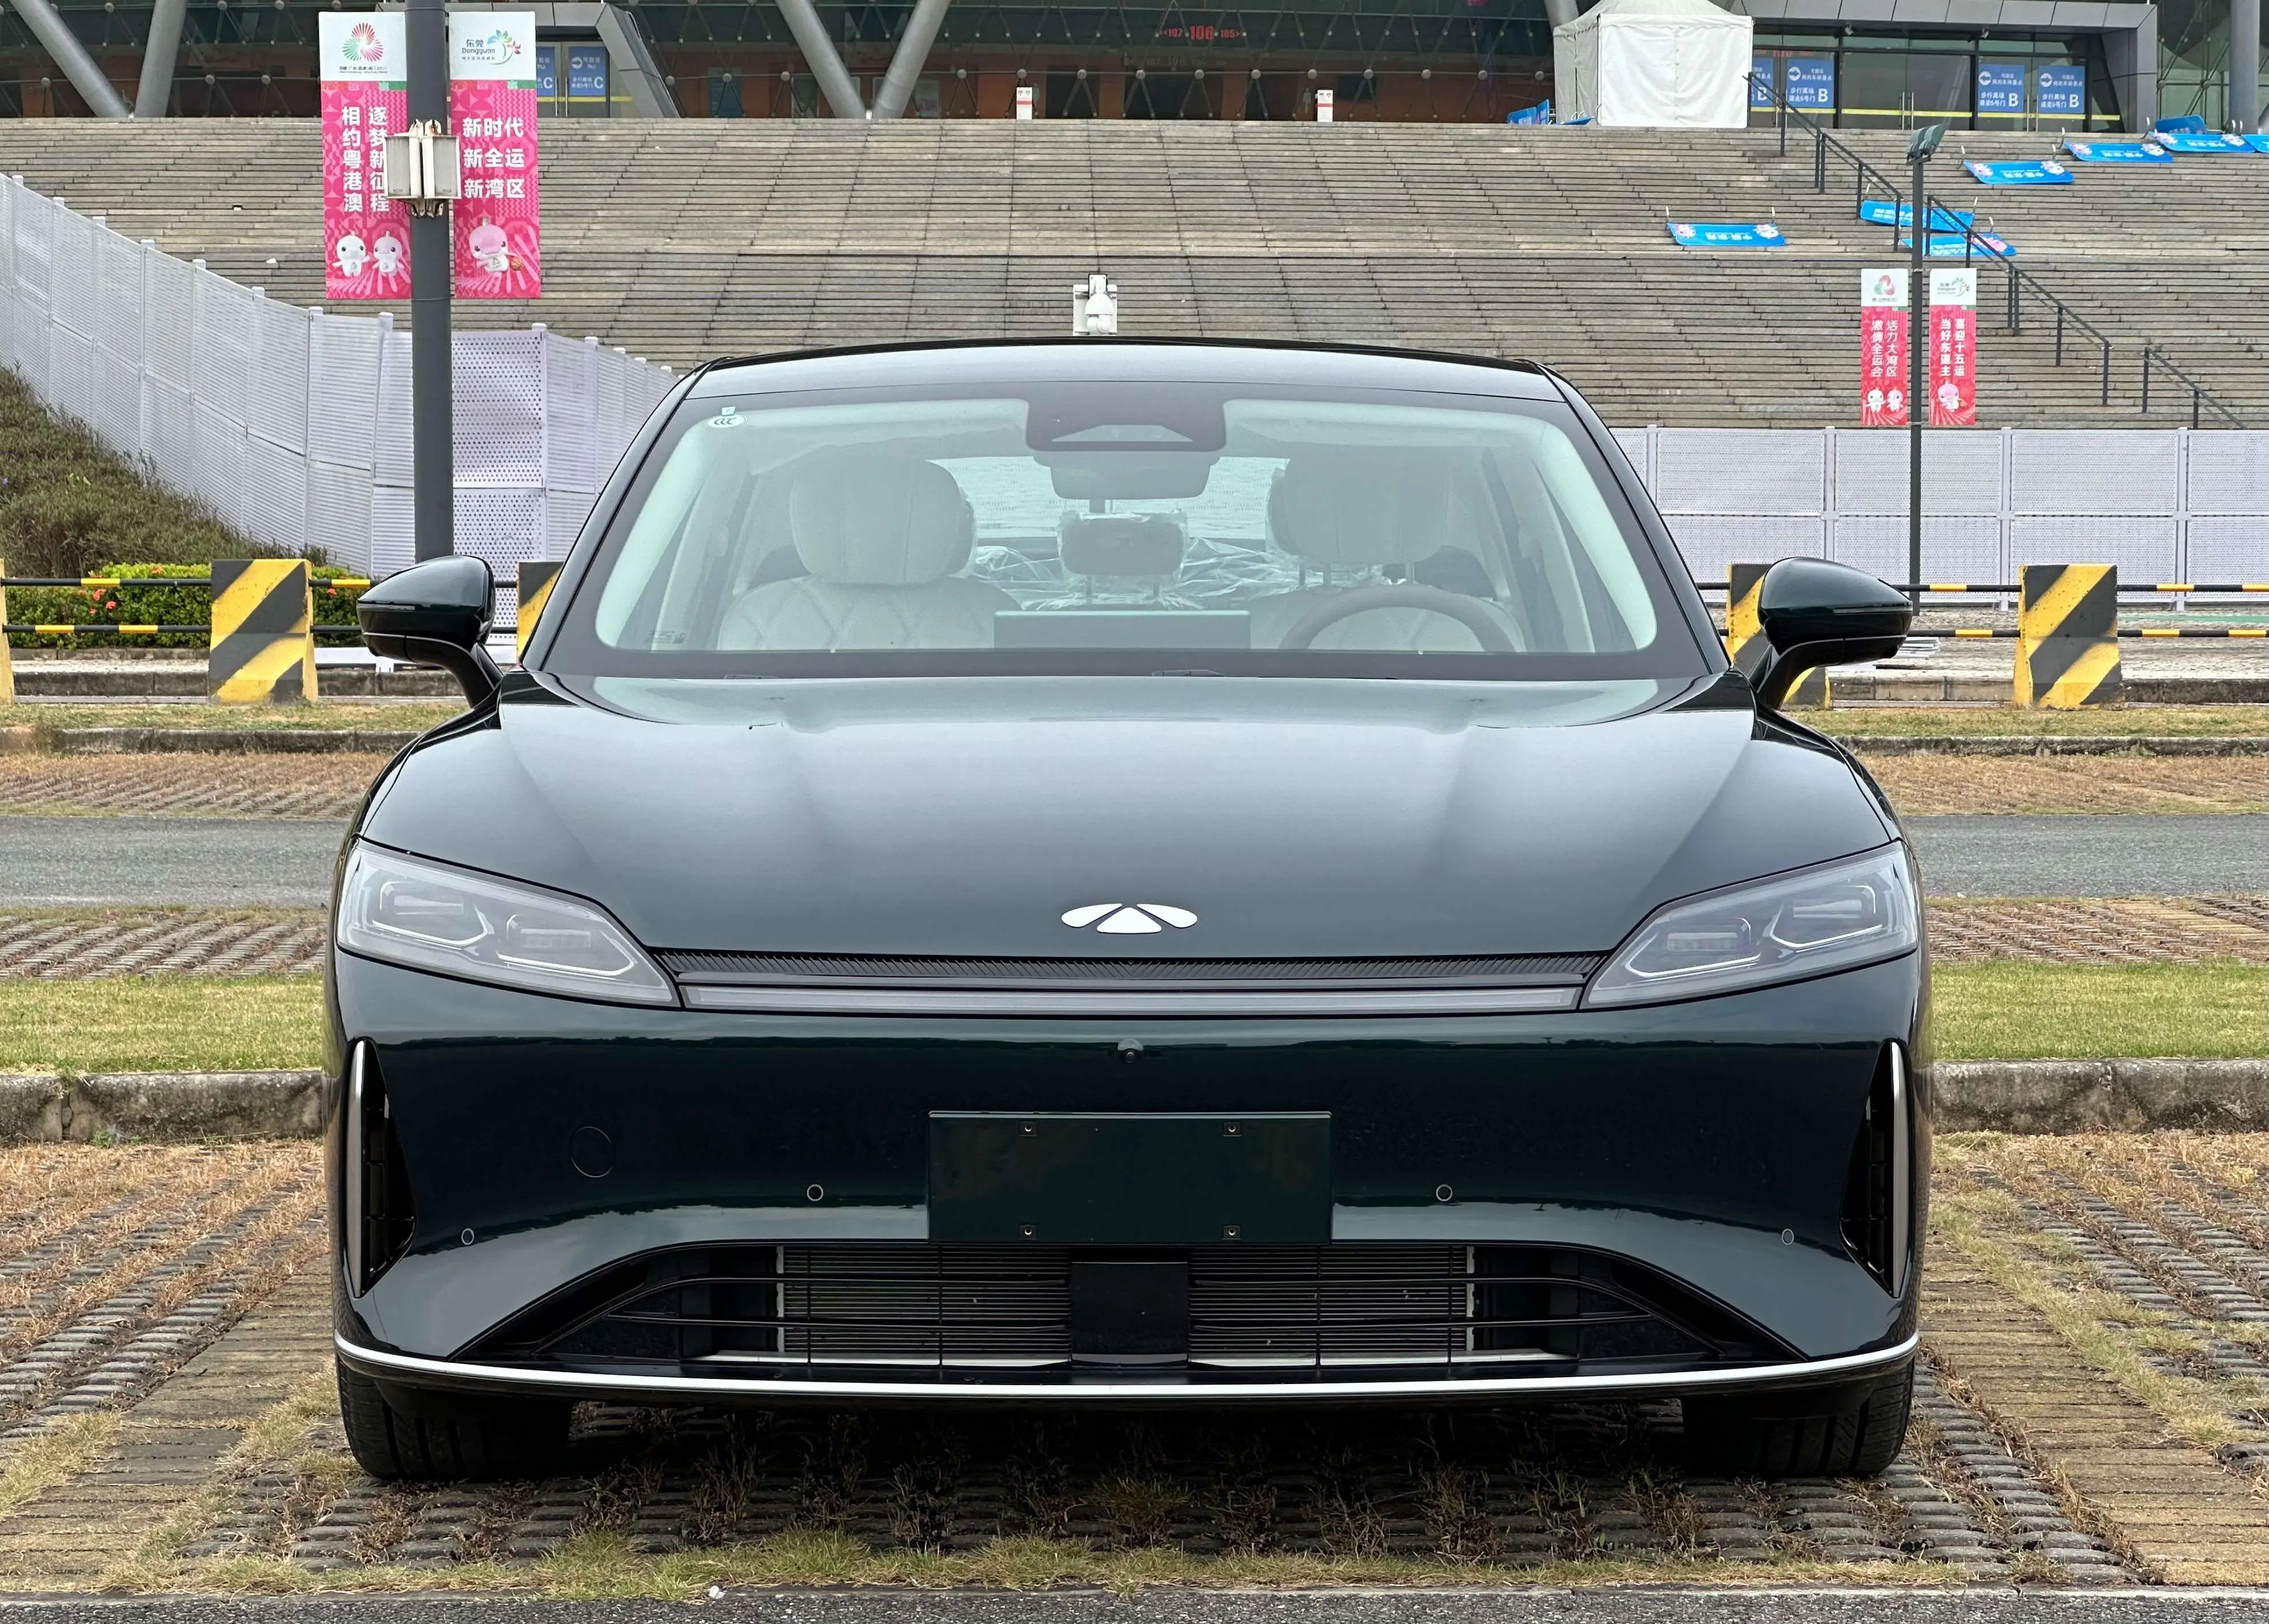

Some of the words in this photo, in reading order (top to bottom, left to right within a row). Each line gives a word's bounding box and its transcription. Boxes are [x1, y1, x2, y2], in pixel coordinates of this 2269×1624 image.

[466, 39, 484, 47] 东莞
[1190, 26, 1214, 40] 106
[543, 77, 553, 89] C
[594, 76, 603, 89] C
[1818, 88, 1828, 102] B
[2008, 93, 2019, 107] B
[2070, 94, 2079, 108] B
[462, 117, 524, 138] 新时代
[342, 106, 363, 212] 相约粤港澳
[369, 106, 390, 212] 逐梦新征程
[463, 147, 525, 168] 新全运
[464, 178, 526, 199] 新湾区
[1871, 319, 1884, 377] 激情全运会
[1886, 320, 1898, 377] 活力大湾区
[1940, 318, 1952, 376] 当好东道主
[1954, 318, 1966, 376] 喜迎十五运
